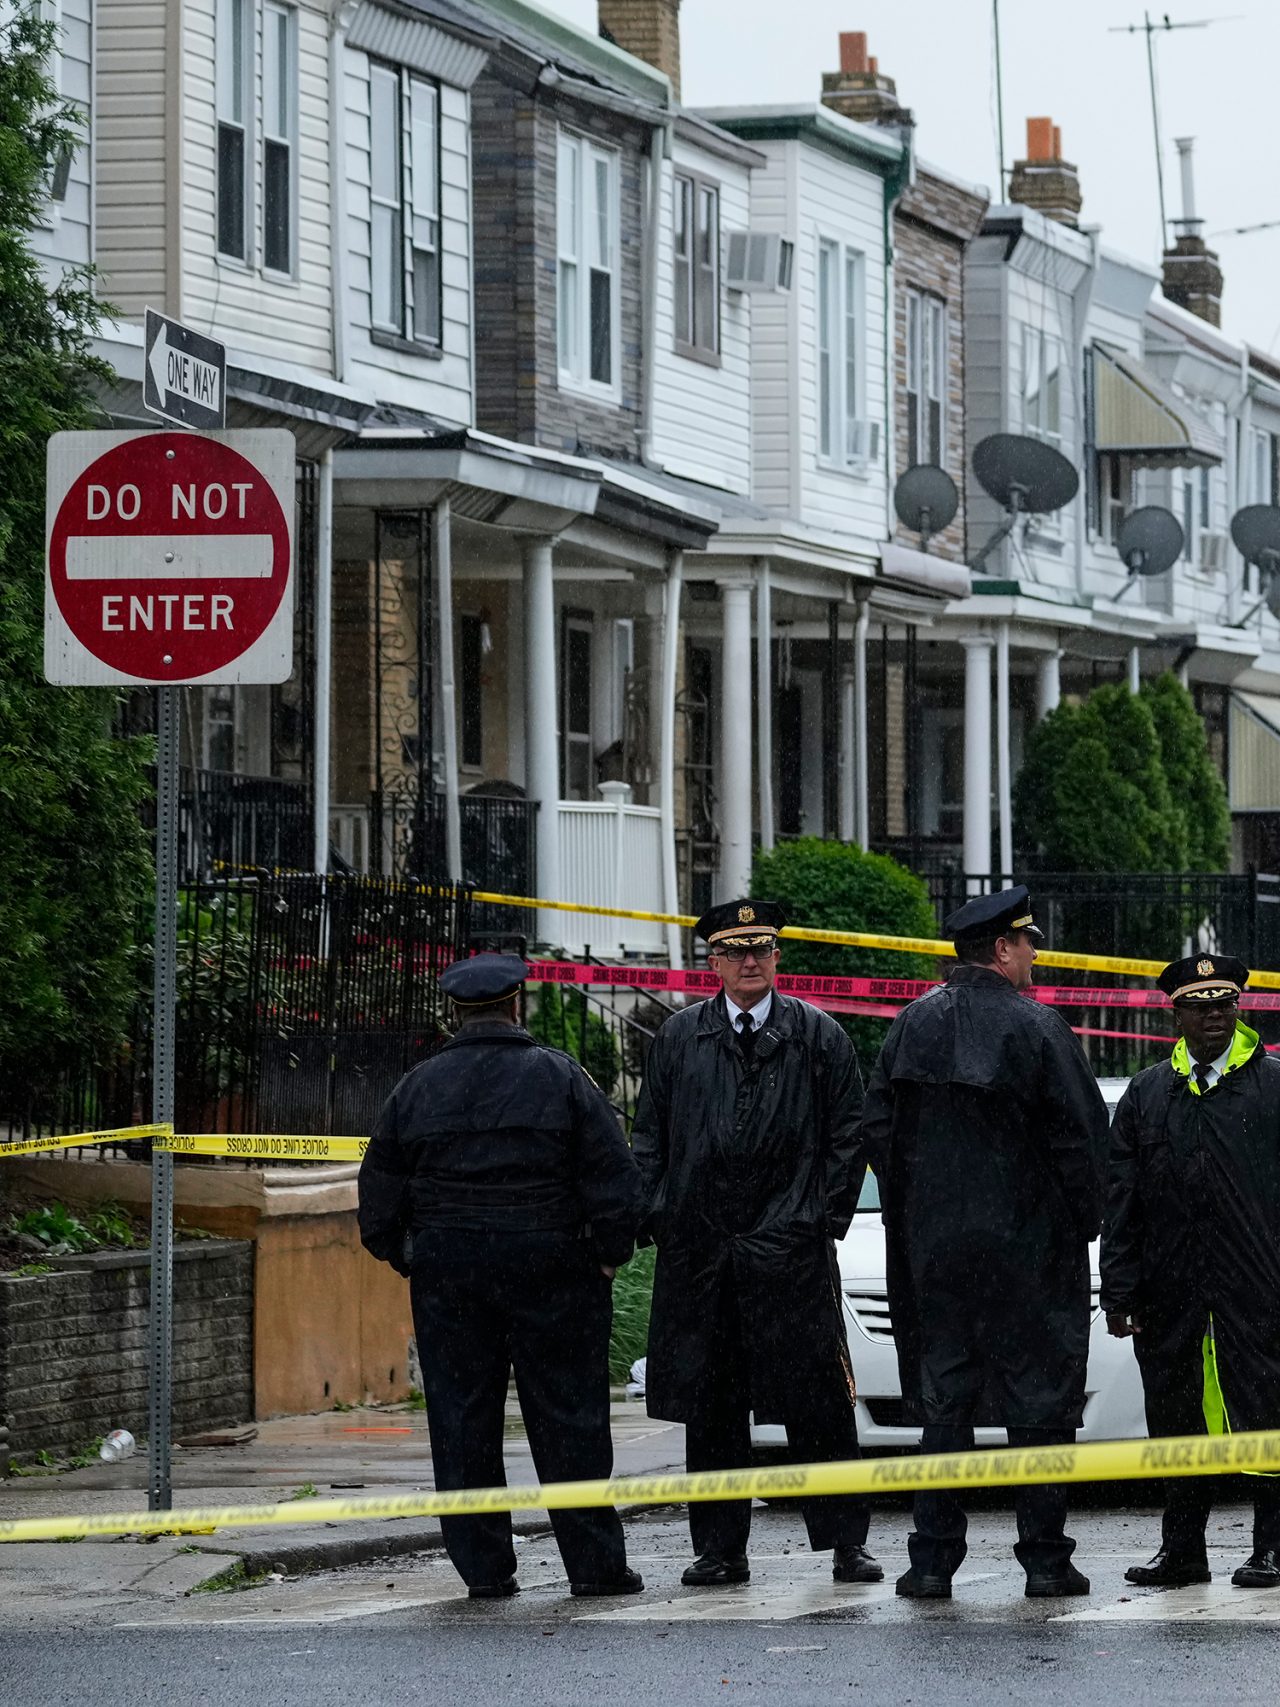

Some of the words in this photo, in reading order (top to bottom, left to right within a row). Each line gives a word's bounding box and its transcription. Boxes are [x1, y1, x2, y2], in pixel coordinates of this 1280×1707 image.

[168, 351, 189, 394] ONE
[193, 362, 217, 405] WAY
[87, 484, 141, 521] DO
[172, 483, 253, 520] NOT
[102, 595, 234, 631] ENTER
[169, 1136, 195, 1150] POLICE
[227, 1137, 252, 1152] CROSS
[254, 1138, 269, 1153] NOT
[271, 1138, 281, 1153] DO
[283, 1138, 300, 1154] LINE
[302, 1139, 329, 1155] POLICE
[1140, 1442, 1193, 1468] POLICE
[1197, 1440, 1231, 1465] LINE
[1235, 1438, 1258, 1463] DO
[871, 1460, 924, 1485] POLICE
[928, 1457, 961, 1482] LINE
[965, 1456, 989, 1480] DO
[991, 1453, 1023, 1478] NOT
[1024, 1450, 1077, 1476] CROSS
[604, 1480, 656, 1499] POLICE
[660, 1478, 693, 1496] LINE
[697, 1476, 720, 1494] DO
[722, 1474, 754, 1493] NOT
[755, 1470, 808, 1492] CROSS
